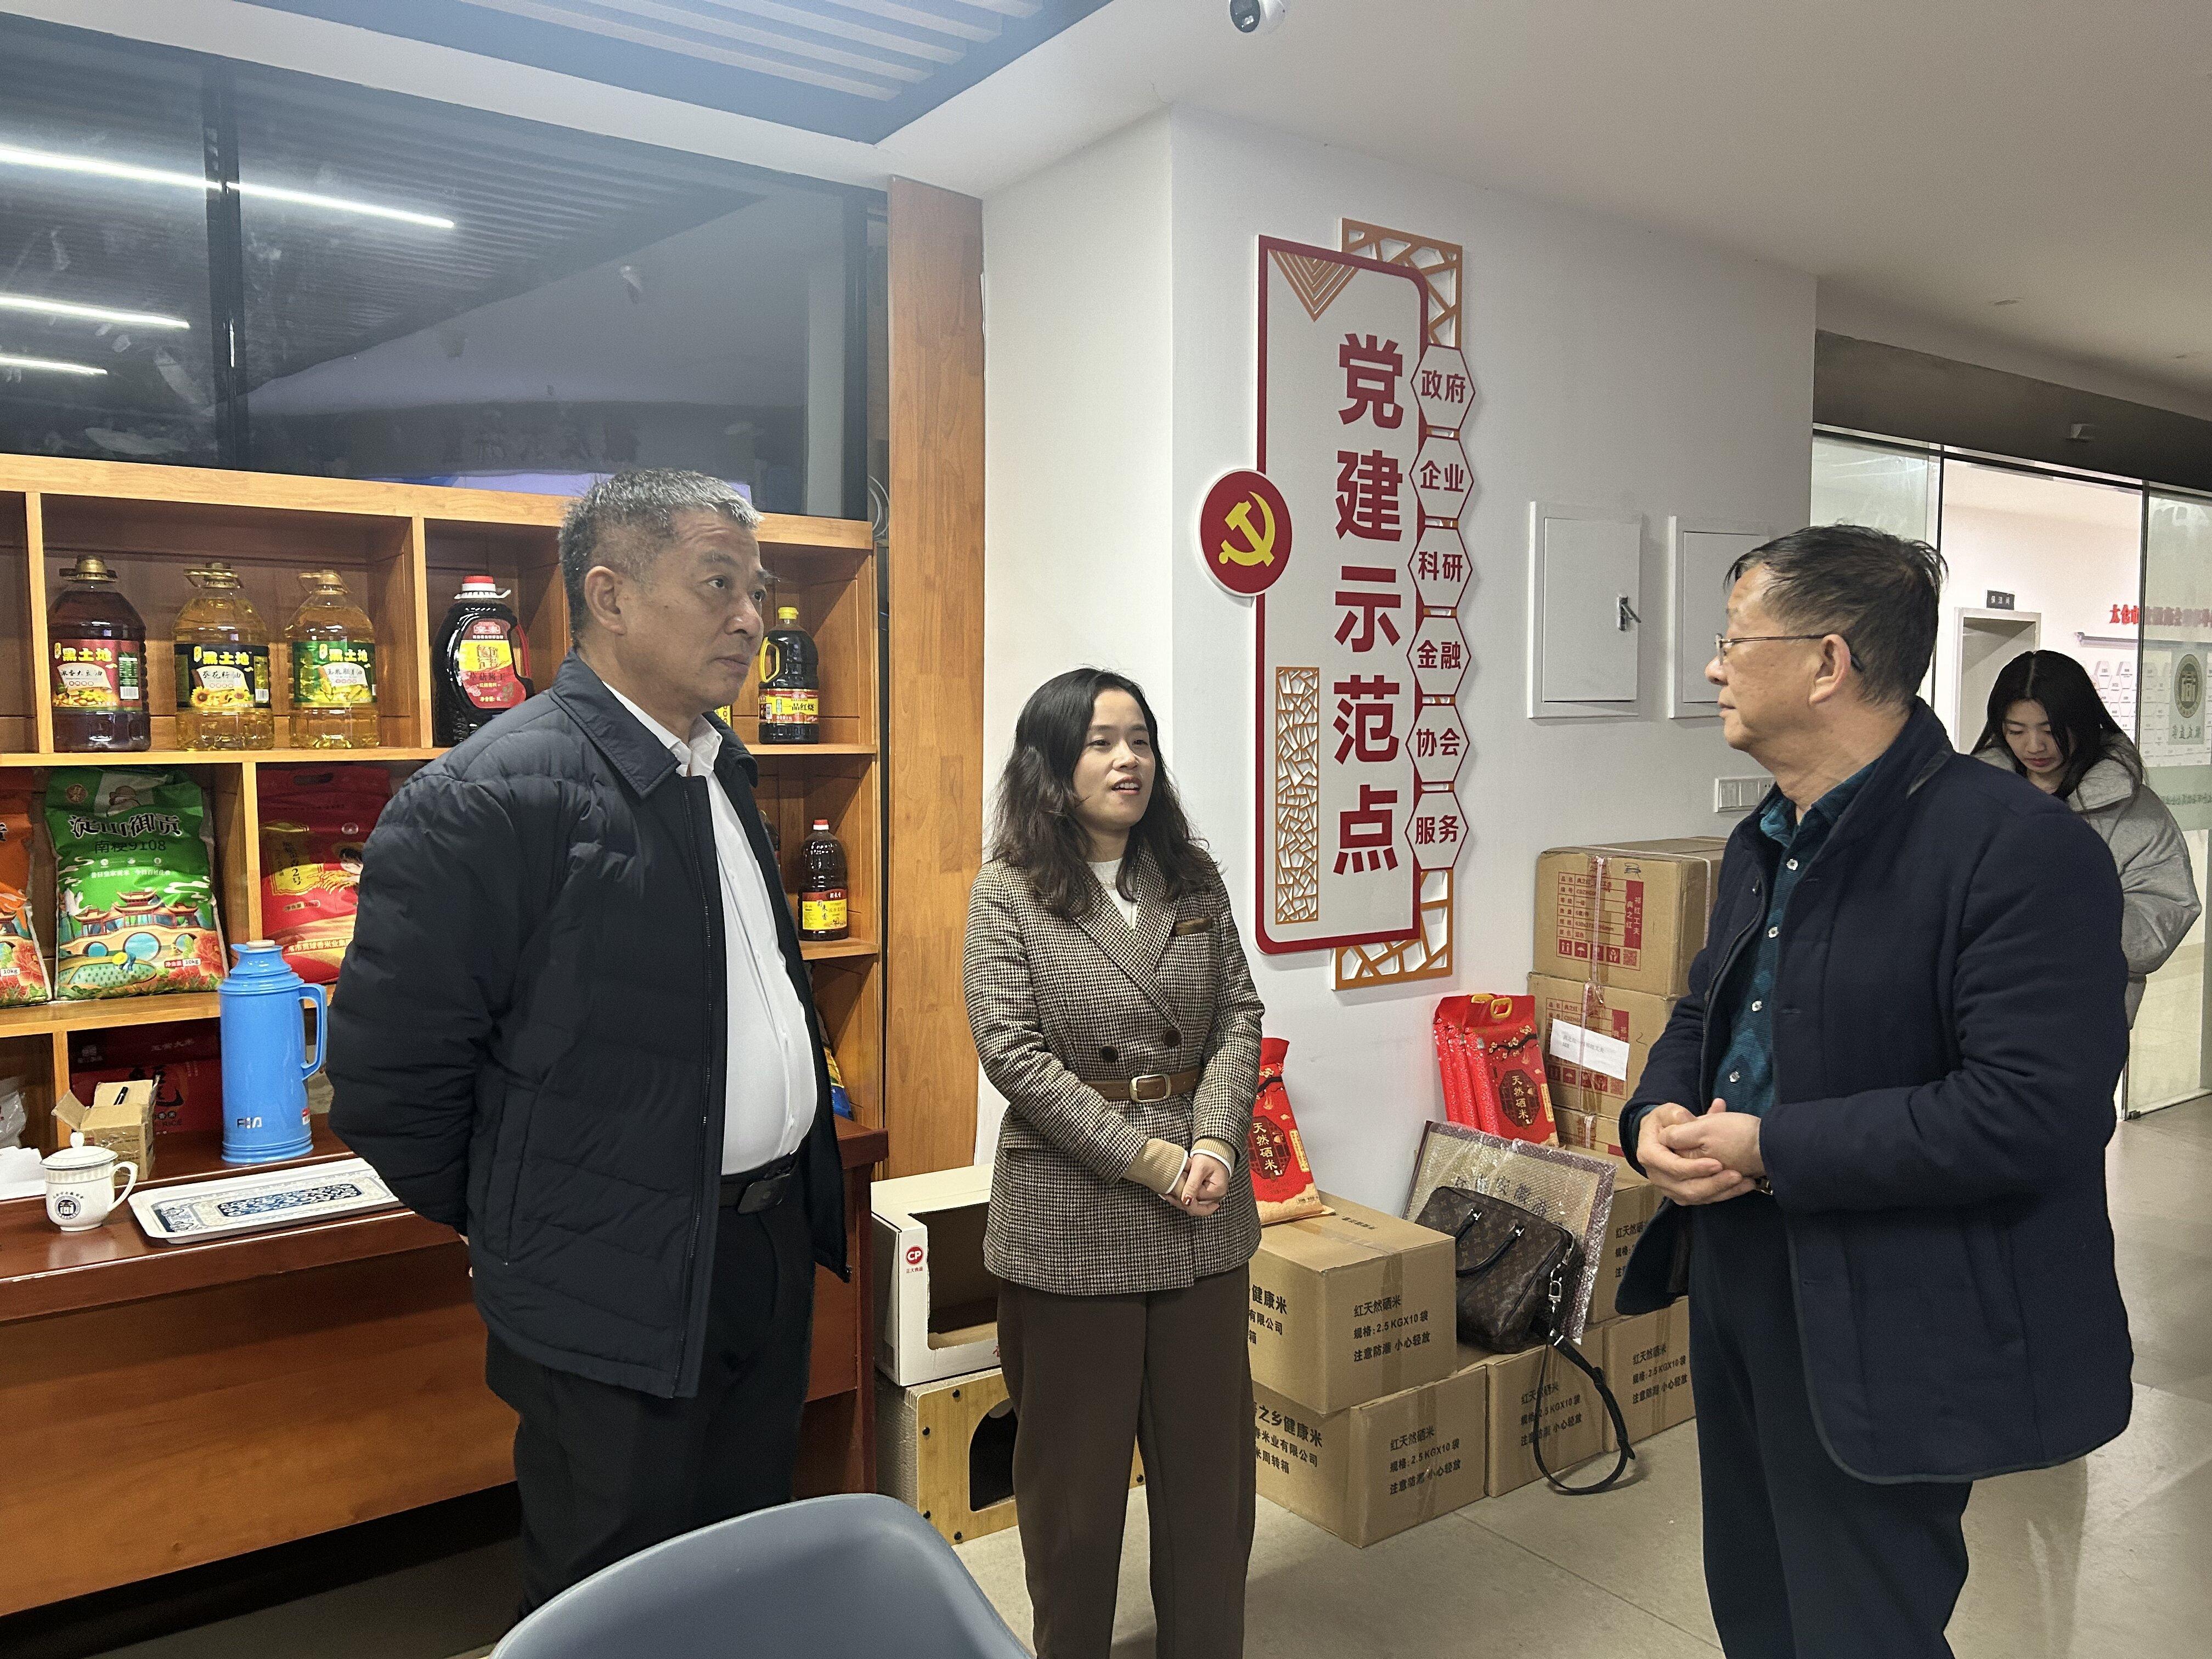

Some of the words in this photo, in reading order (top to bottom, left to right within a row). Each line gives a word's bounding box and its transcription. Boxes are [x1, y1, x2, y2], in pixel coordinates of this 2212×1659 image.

[1421, 369, 1466, 403] 政府
[1420, 461, 1464, 493] 企业
[1418, 552, 1463, 583] 科研
[1333, 333, 1404, 875] 党建示范点
[62, 647, 112, 662] 黑土地
[203, 651, 250, 665] 黑土地
[329, 648, 368, 662] 黑土地
[1417, 640, 1462, 670] 金融
[1416, 727, 1460, 758] 协会
[1415, 814, 1459, 845] 服务
[1511, 1075, 1529, 1119] 天然硒米
[1253, 1122, 1278, 1171] 天然硒米
[907, 1250, 922, 1261] CP
[1354, 1295, 1401, 1317] 红天然硒米
[1249, 1309, 1283, 1335] 有限公司
[1354, 1342, 1391, 1362] 注意防潮
[1395, 1331, 1430, 1351] 小心轻放
[1521, 1381, 1559, 1405] 红天硒米
[1254, 1401, 1322, 1448] 之乡健康米
